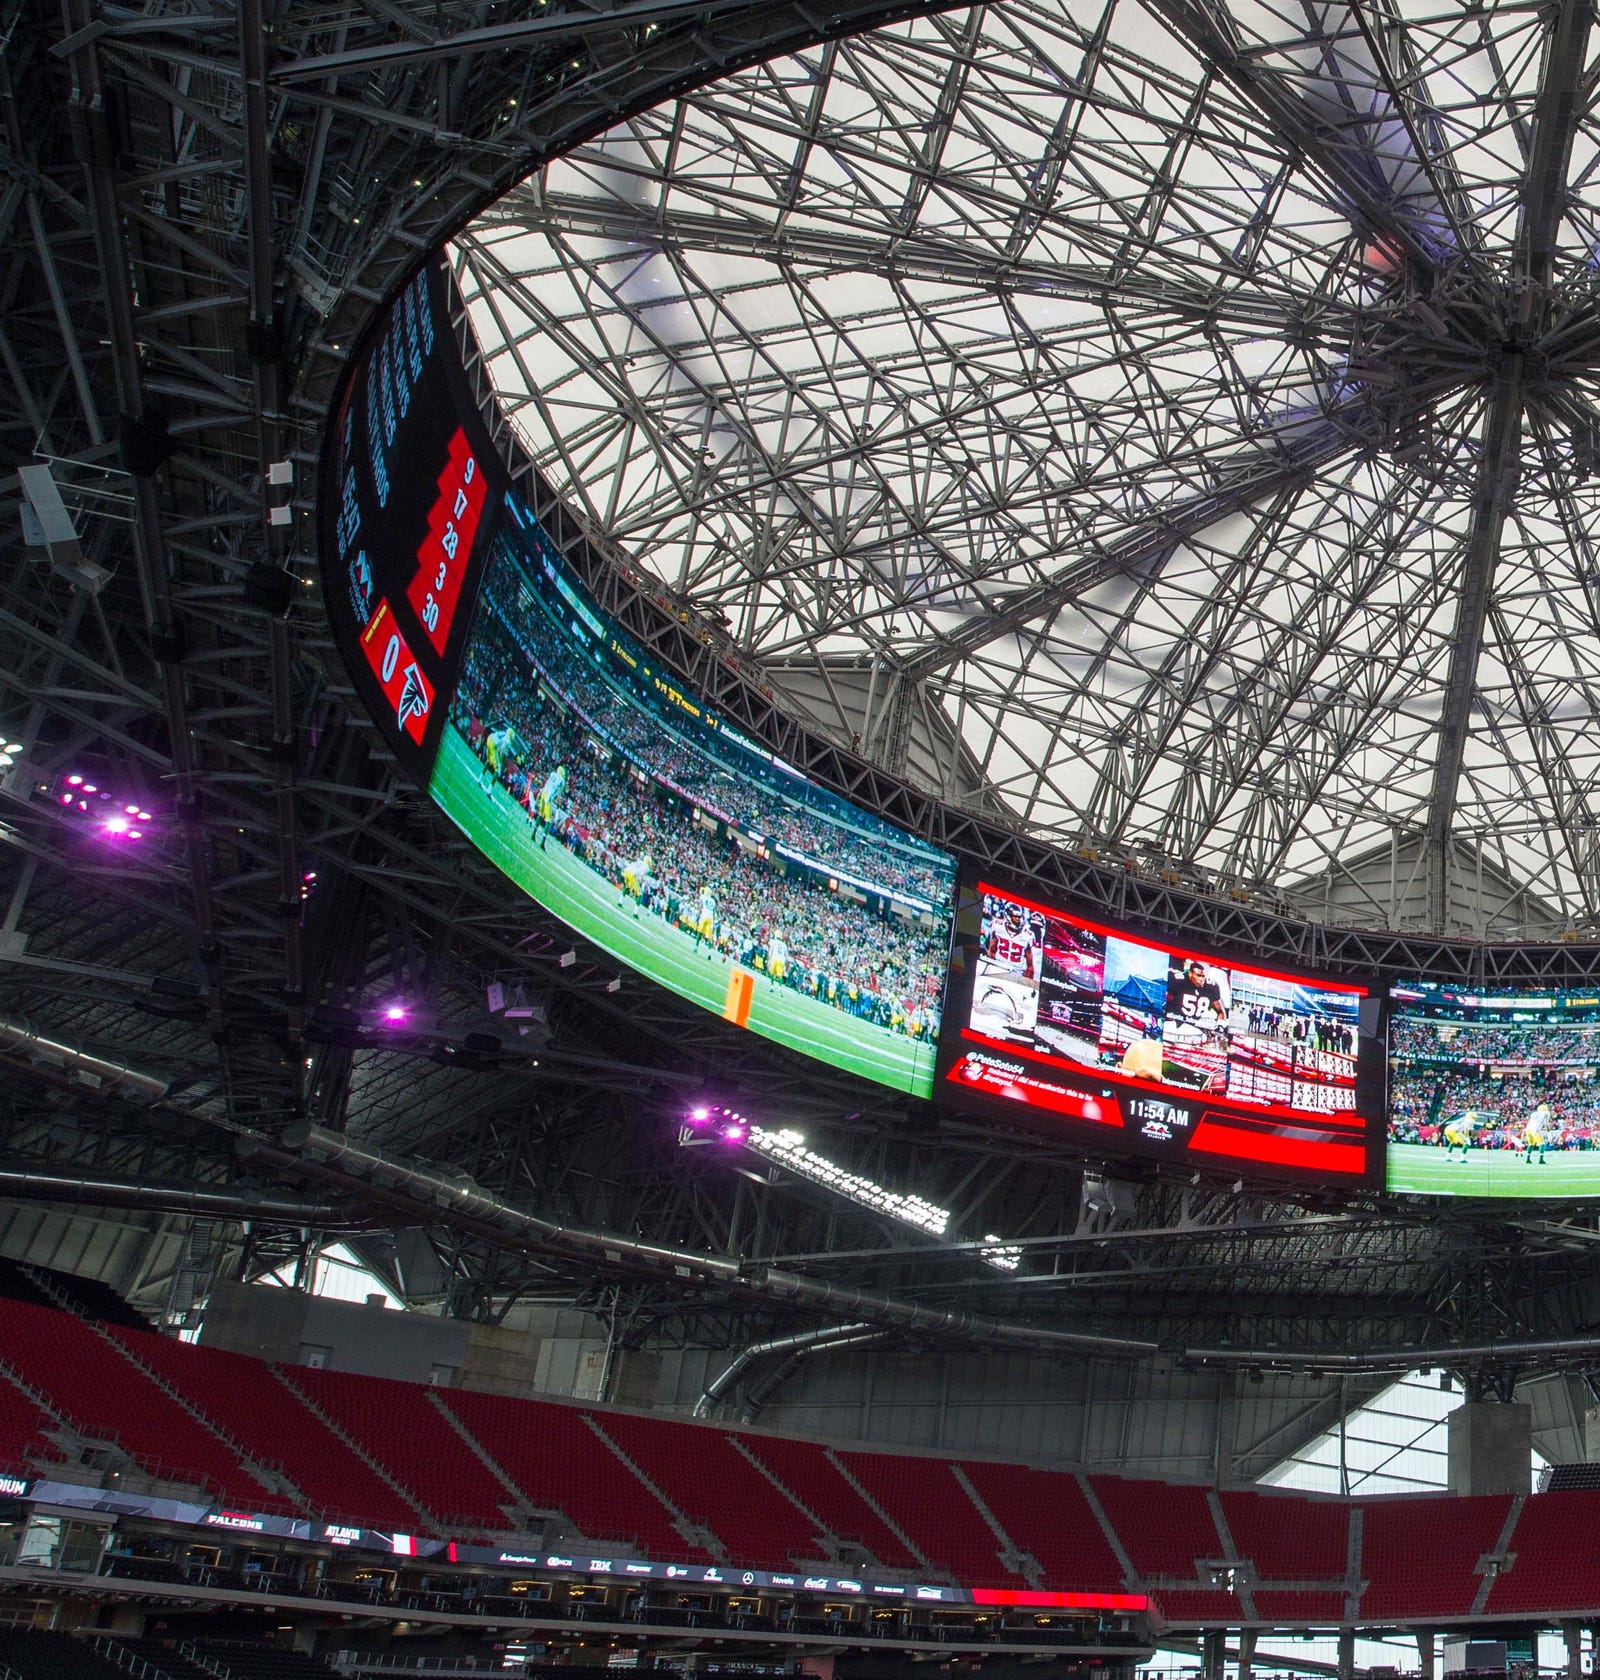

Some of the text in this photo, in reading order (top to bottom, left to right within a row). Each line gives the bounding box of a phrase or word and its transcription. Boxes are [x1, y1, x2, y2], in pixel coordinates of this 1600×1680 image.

[464, 457, 475, 485] 9
[454, 488, 468, 521] 17
[442, 520, 459, 560] 28
[435, 561, 446, 591] 3
[422, 592, 439, 633] 30
[382, 634, 400, 683] 0
[999, 938, 1023, 963] 22
[1181, 993, 1211, 1019] 58
[1130, 1099, 1189, 1126] 11:54 AM
[208, 1514, 264, 1530] FALCONS
[326, 1525, 361, 1540] ATLANTA
[590, 1559, 613, 1572] IBM
